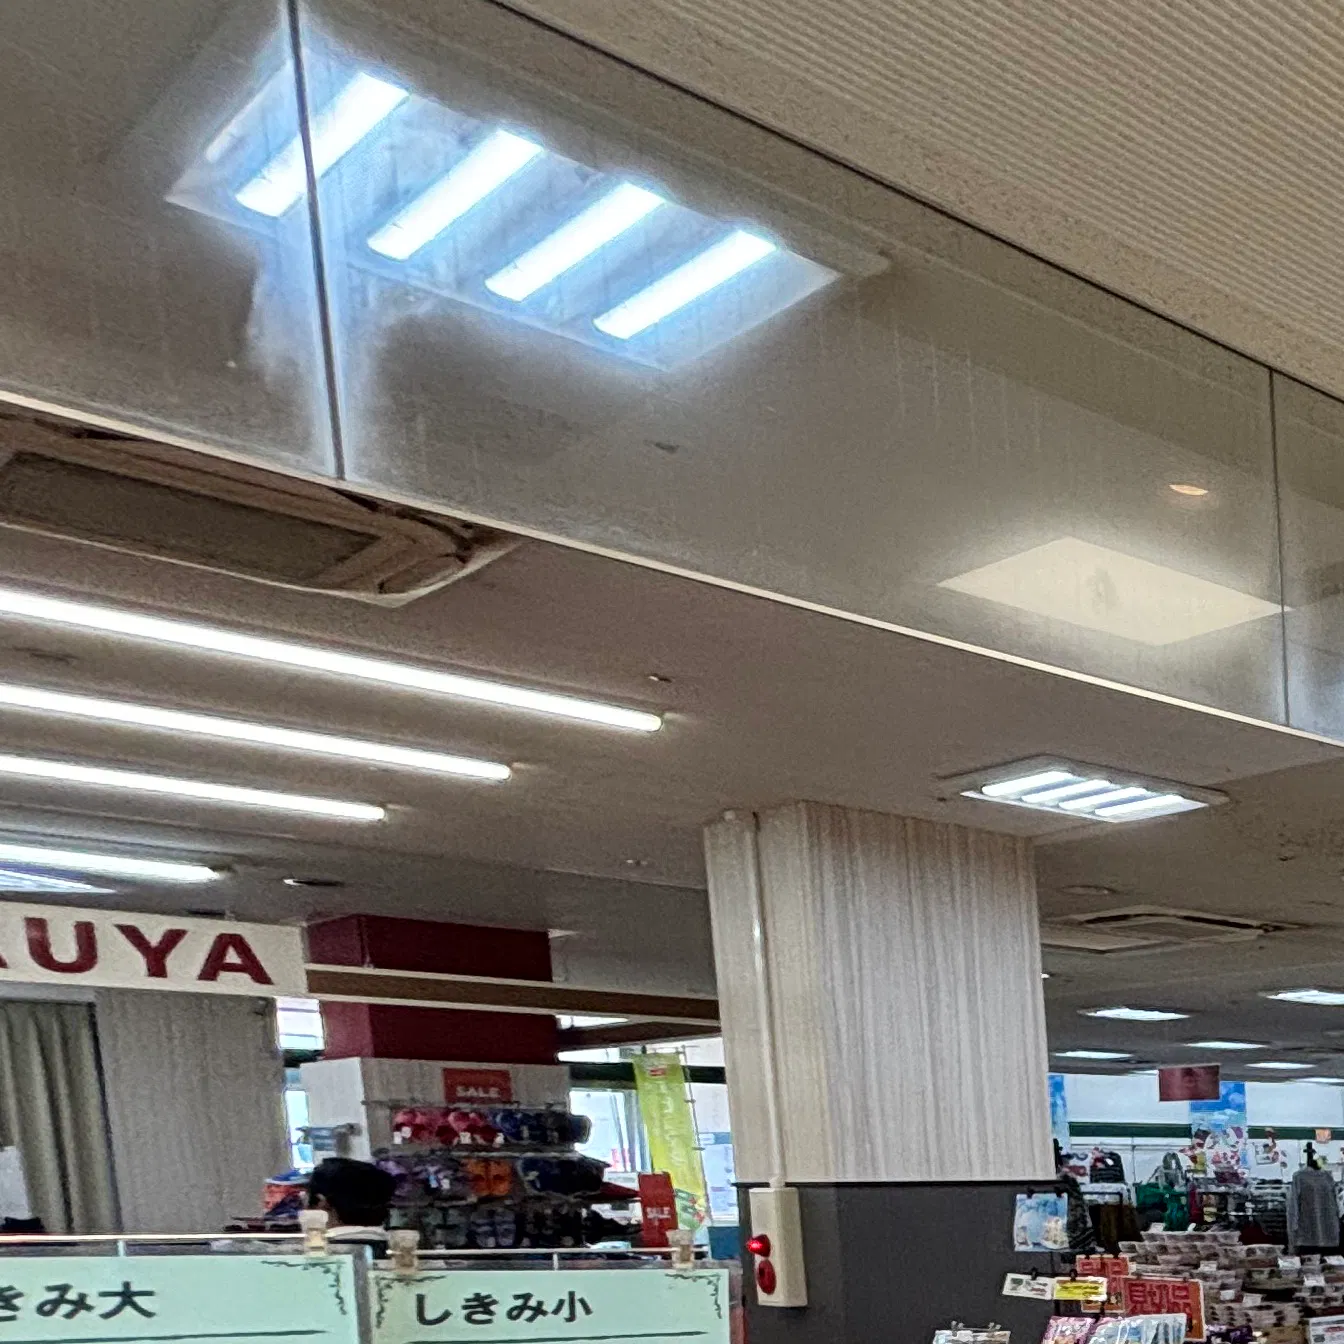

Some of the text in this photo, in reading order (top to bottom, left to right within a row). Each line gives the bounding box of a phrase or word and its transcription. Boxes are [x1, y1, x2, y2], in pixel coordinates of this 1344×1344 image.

[0, 916, 274, 984] UYA
[457, 1086, 501, 1098] SALE
[415, 1291, 593, 1325] しきみ小
